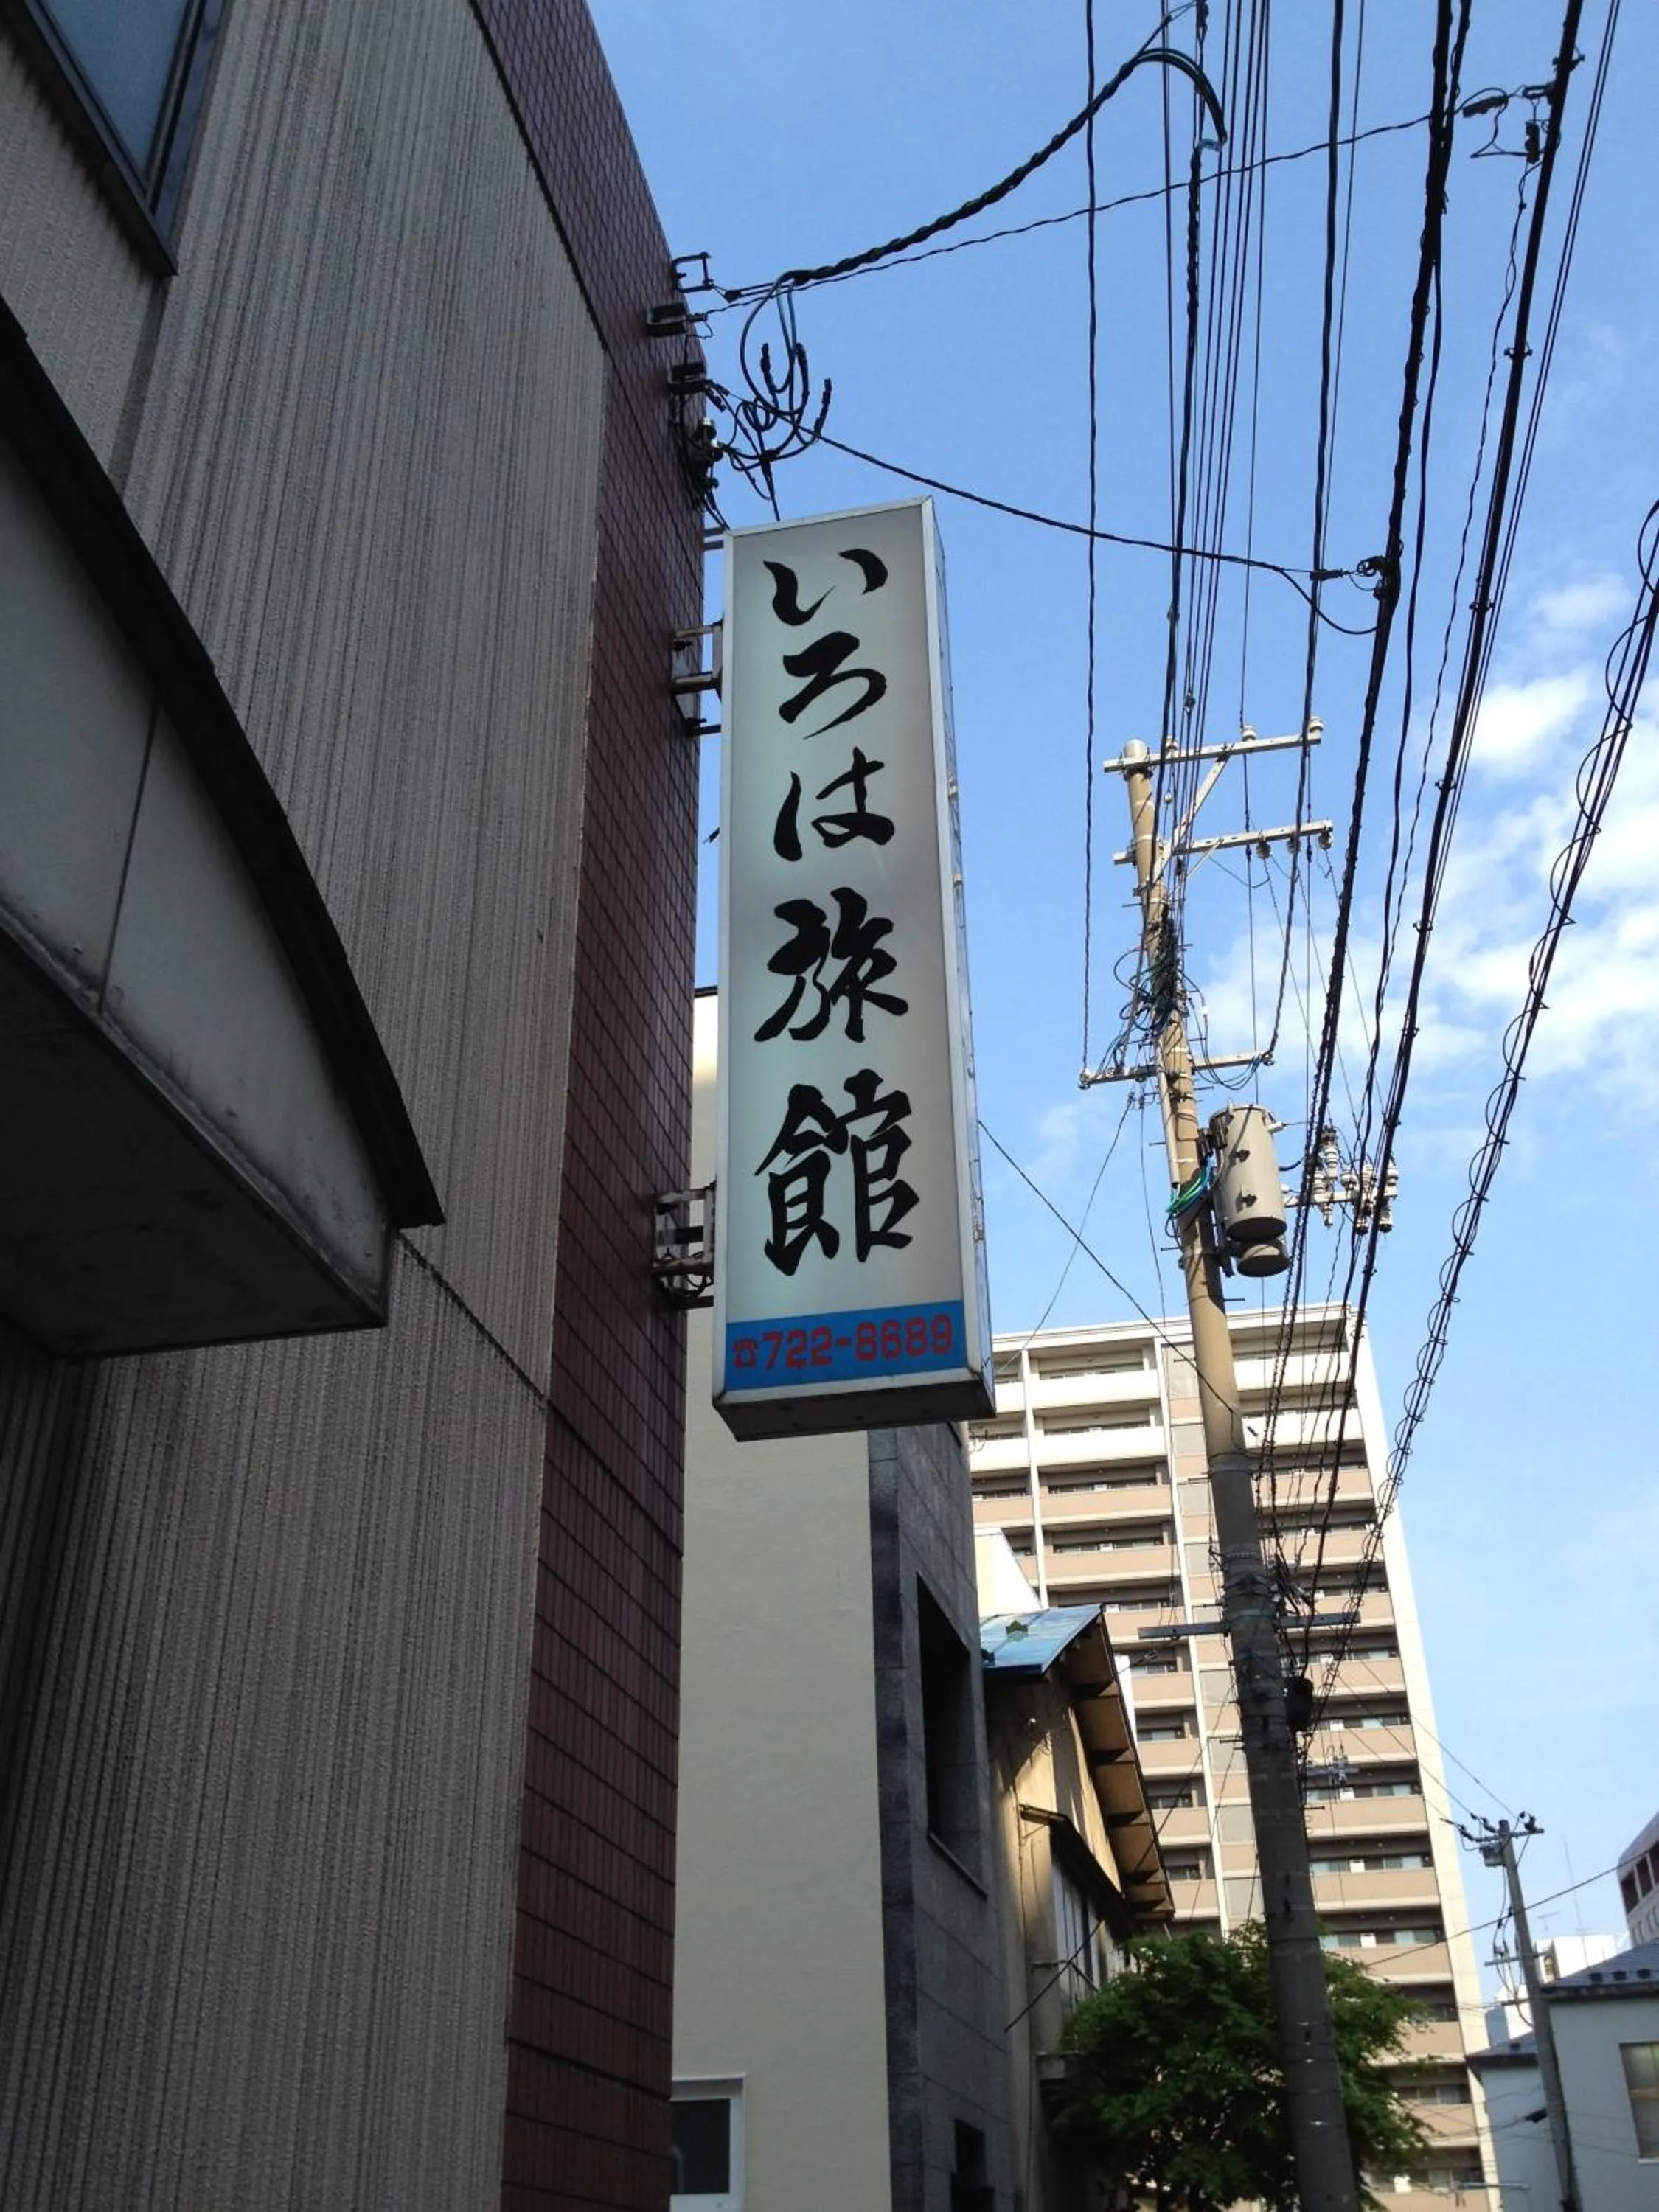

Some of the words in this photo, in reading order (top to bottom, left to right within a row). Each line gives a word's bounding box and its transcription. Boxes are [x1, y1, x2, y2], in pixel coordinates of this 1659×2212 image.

[754, 549, 919, 1276] いろは旅館
